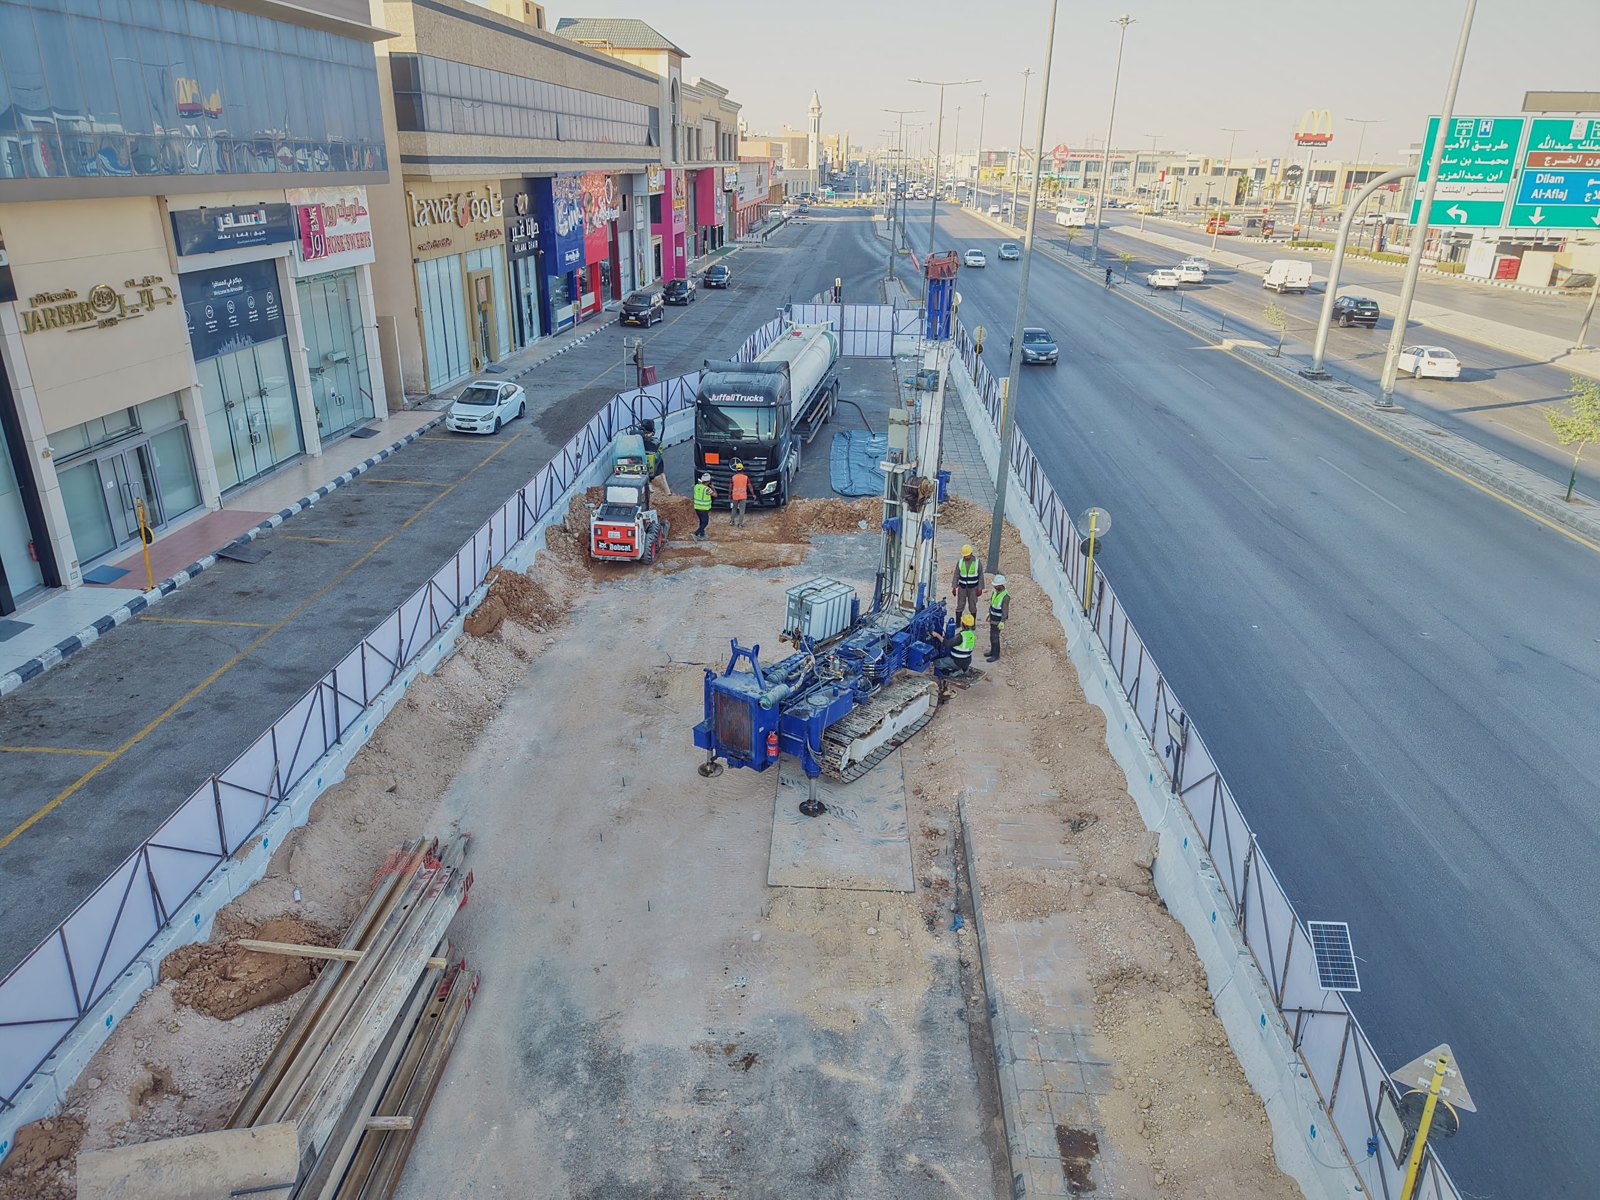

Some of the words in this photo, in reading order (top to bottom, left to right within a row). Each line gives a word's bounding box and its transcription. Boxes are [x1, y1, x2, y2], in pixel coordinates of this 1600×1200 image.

[1445, 136, 1470, 151] الأمي
[1471, 139, 1508, 151] طريق
[1460, 157, 1472, 166] بن
[1474, 157, 1509, 165] محمد
[1544, 154, 1583, 167] الخرج
[1438, 170, 1484, 181] عبدالعزي
[1486, 170, 1503, 182] ابن
[1535, 173, 1565, 184] Dilam
[1530, 188, 1569, 202] Al-Aflaj
[326, 235, 345, 254] ROSE
[345, 231, 372, 251] SWEETS
[21, 302, 97, 335] JAREER
[609, 543, 633, 552] Bobcat
